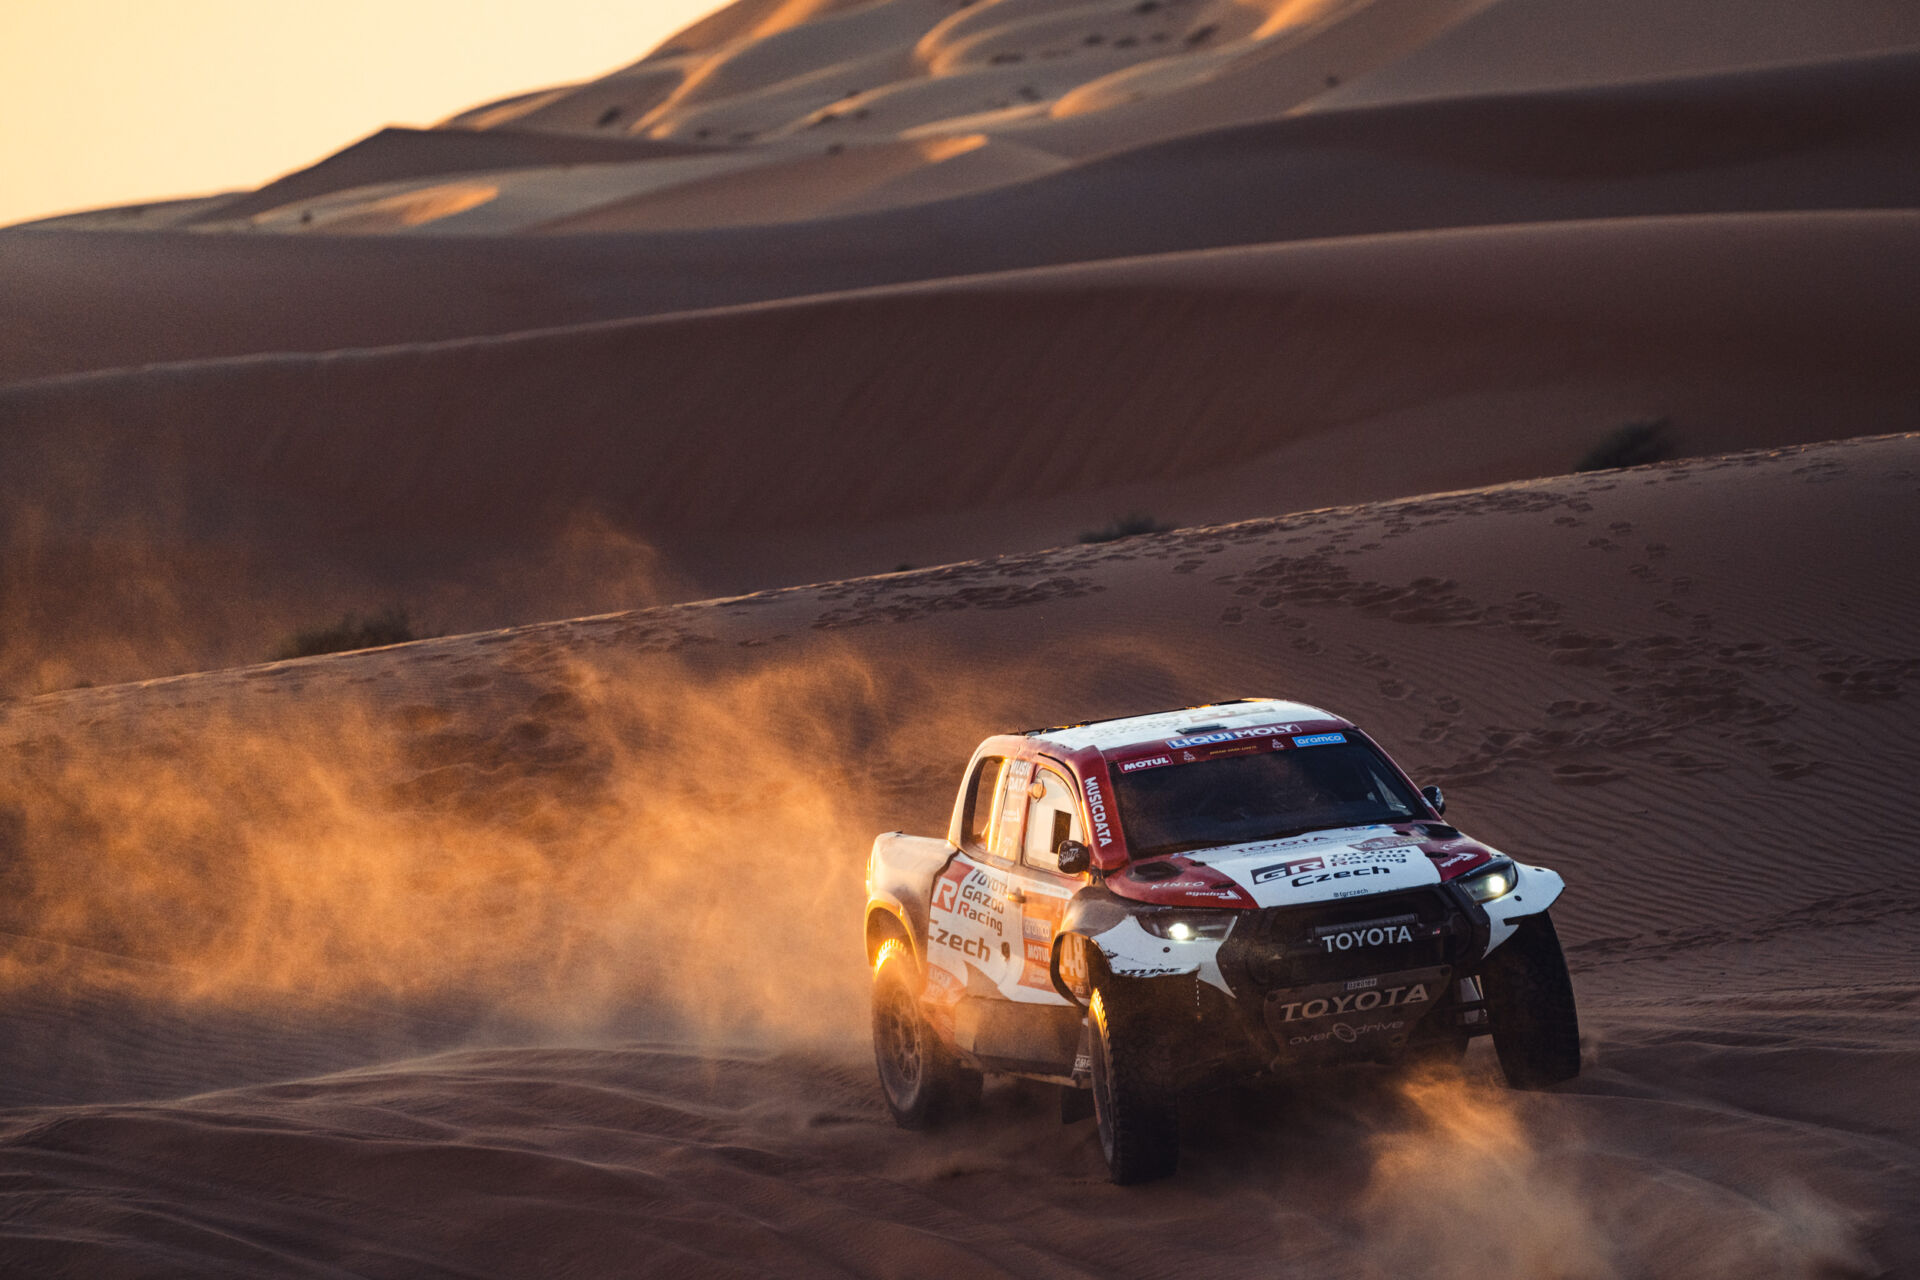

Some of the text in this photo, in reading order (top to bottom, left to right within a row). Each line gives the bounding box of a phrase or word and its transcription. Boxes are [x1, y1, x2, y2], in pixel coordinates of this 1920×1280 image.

[1169, 724, 1296, 748] LIQUI MOLY
[1297, 735, 1342, 745] aramco
[1123, 757, 1169, 771] MOTUL
[1084, 776, 1113, 847] MUSICDATA
[1254, 860, 1322, 883] GR
[1332, 859, 1407, 867] Racing
[1151, 881, 1205, 890] KINTO
[1291, 866, 1390, 888] Czech
[962, 884, 1004, 915] GAZOO
[957, 901, 1003, 937] Racing
[1322, 925, 1413, 953] TOYOTA
[1280, 983, 1430, 1022] TOYOTA
